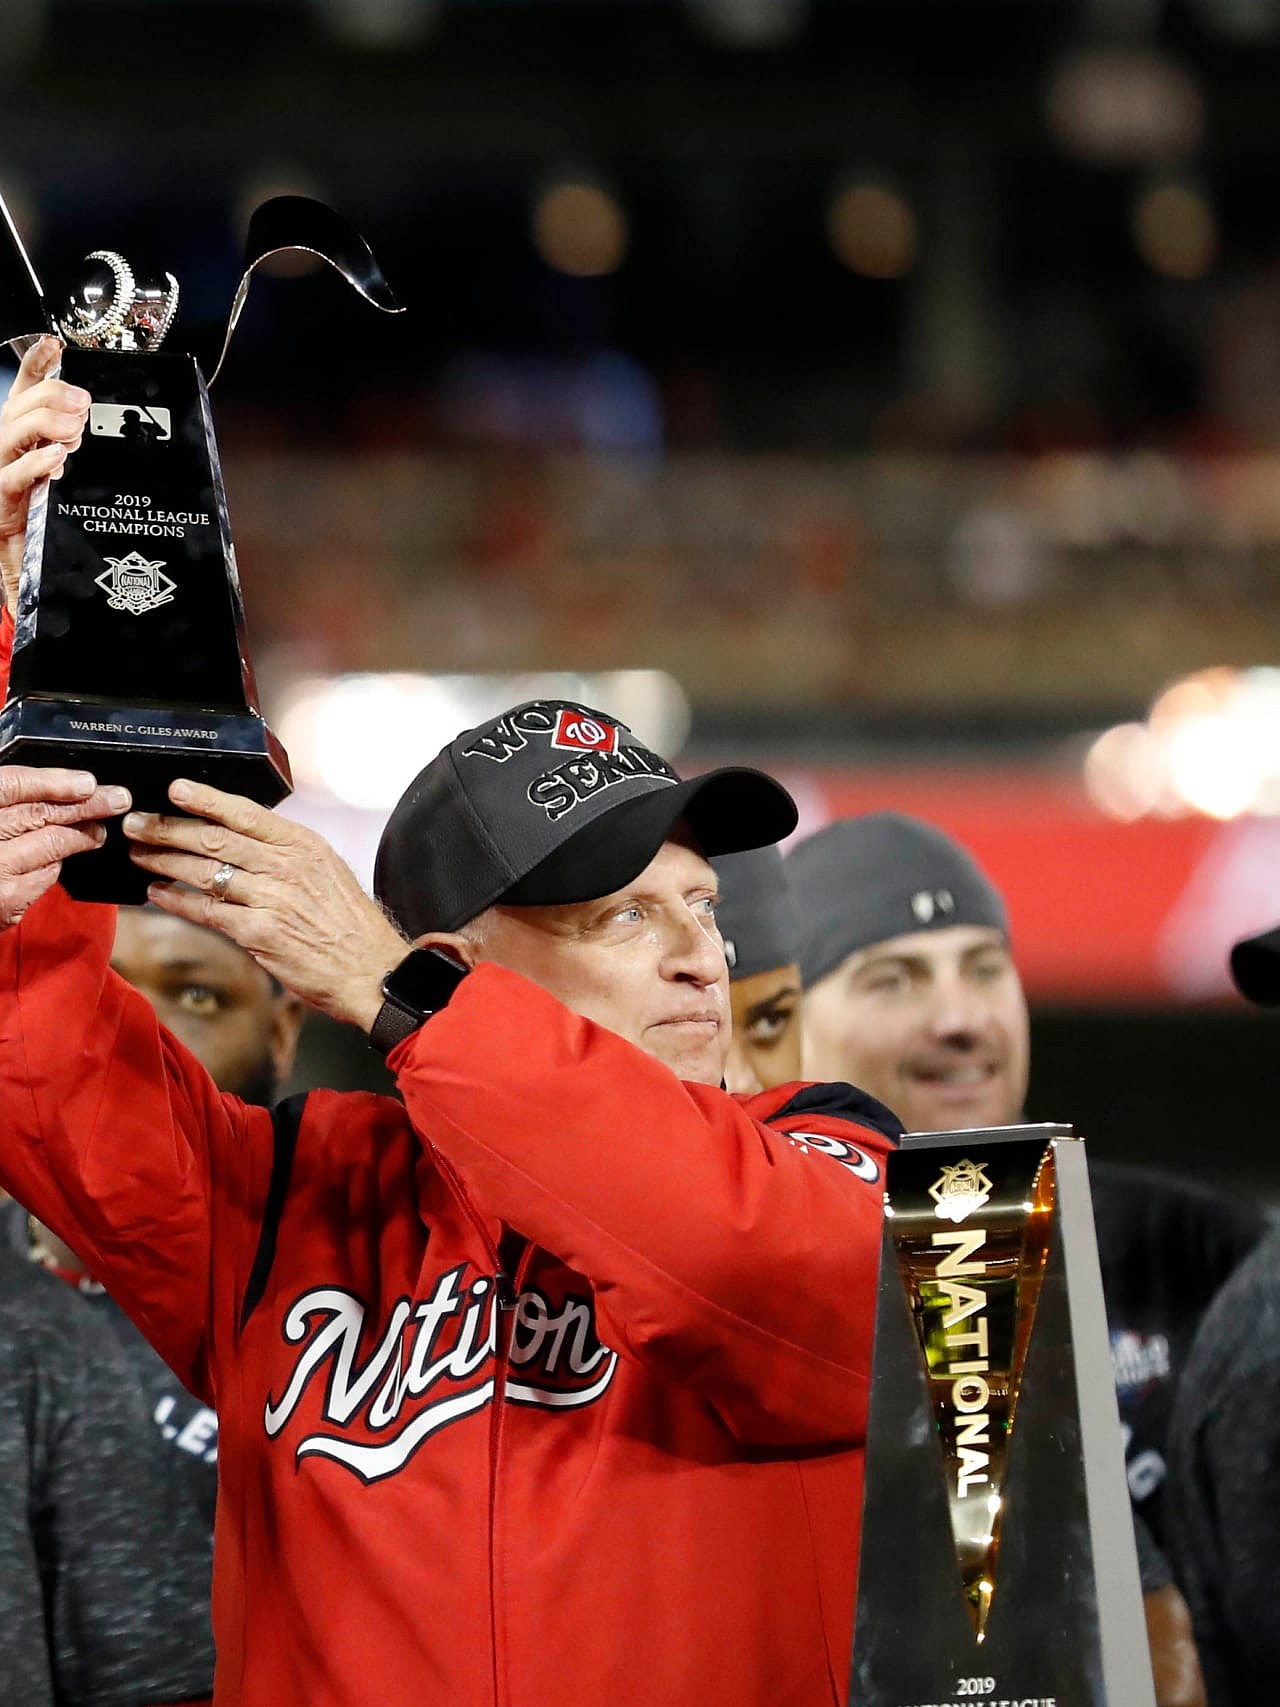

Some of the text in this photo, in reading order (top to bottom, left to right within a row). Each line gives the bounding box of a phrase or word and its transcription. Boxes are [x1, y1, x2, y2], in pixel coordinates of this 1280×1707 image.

[114, 494, 152, 508] 2019
[57, 503, 210, 526] NATIONAL LEAGUE
[83, 520, 185, 538] CHAMPIONS
[70, 720, 218, 740] WARREN C. GILES AWARD
[931, 1229, 990, 1498] NATIONAL
[955, 1676, 996, 1696] 2019
